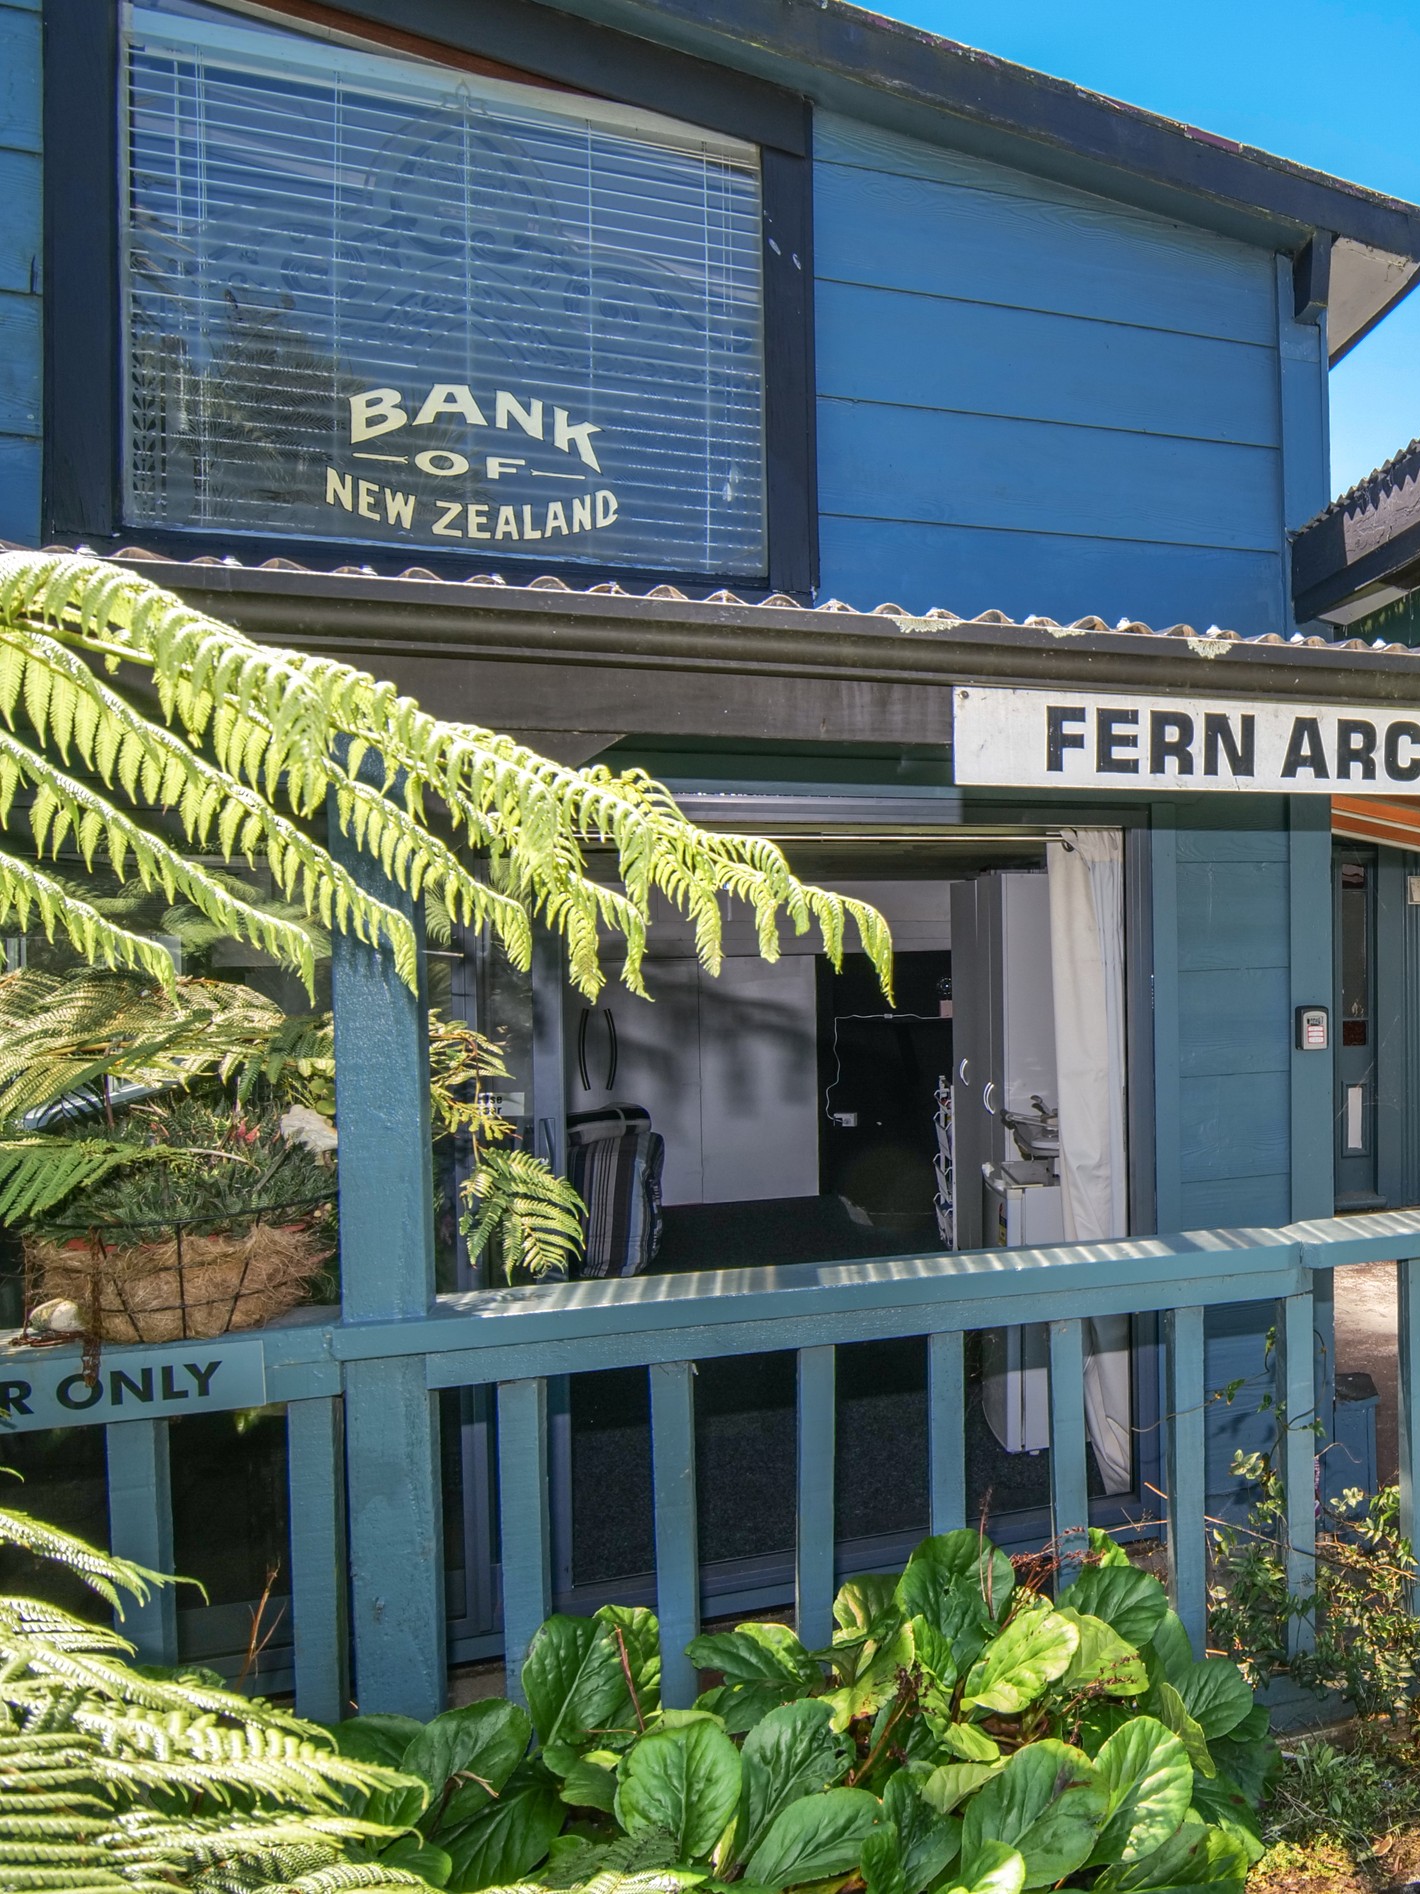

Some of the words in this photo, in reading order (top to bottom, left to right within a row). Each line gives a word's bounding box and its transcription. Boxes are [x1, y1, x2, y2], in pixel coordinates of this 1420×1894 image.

[348, 383, 606, 476] BANK
[414, 450, 526, 480] OF
[325, 465, 417, 531] NEW
[430, 489, 620, 541] ZEALAND
[1045, 705, 1256, 778] FERN
[56, 1360, 223, 1411] ONLY
